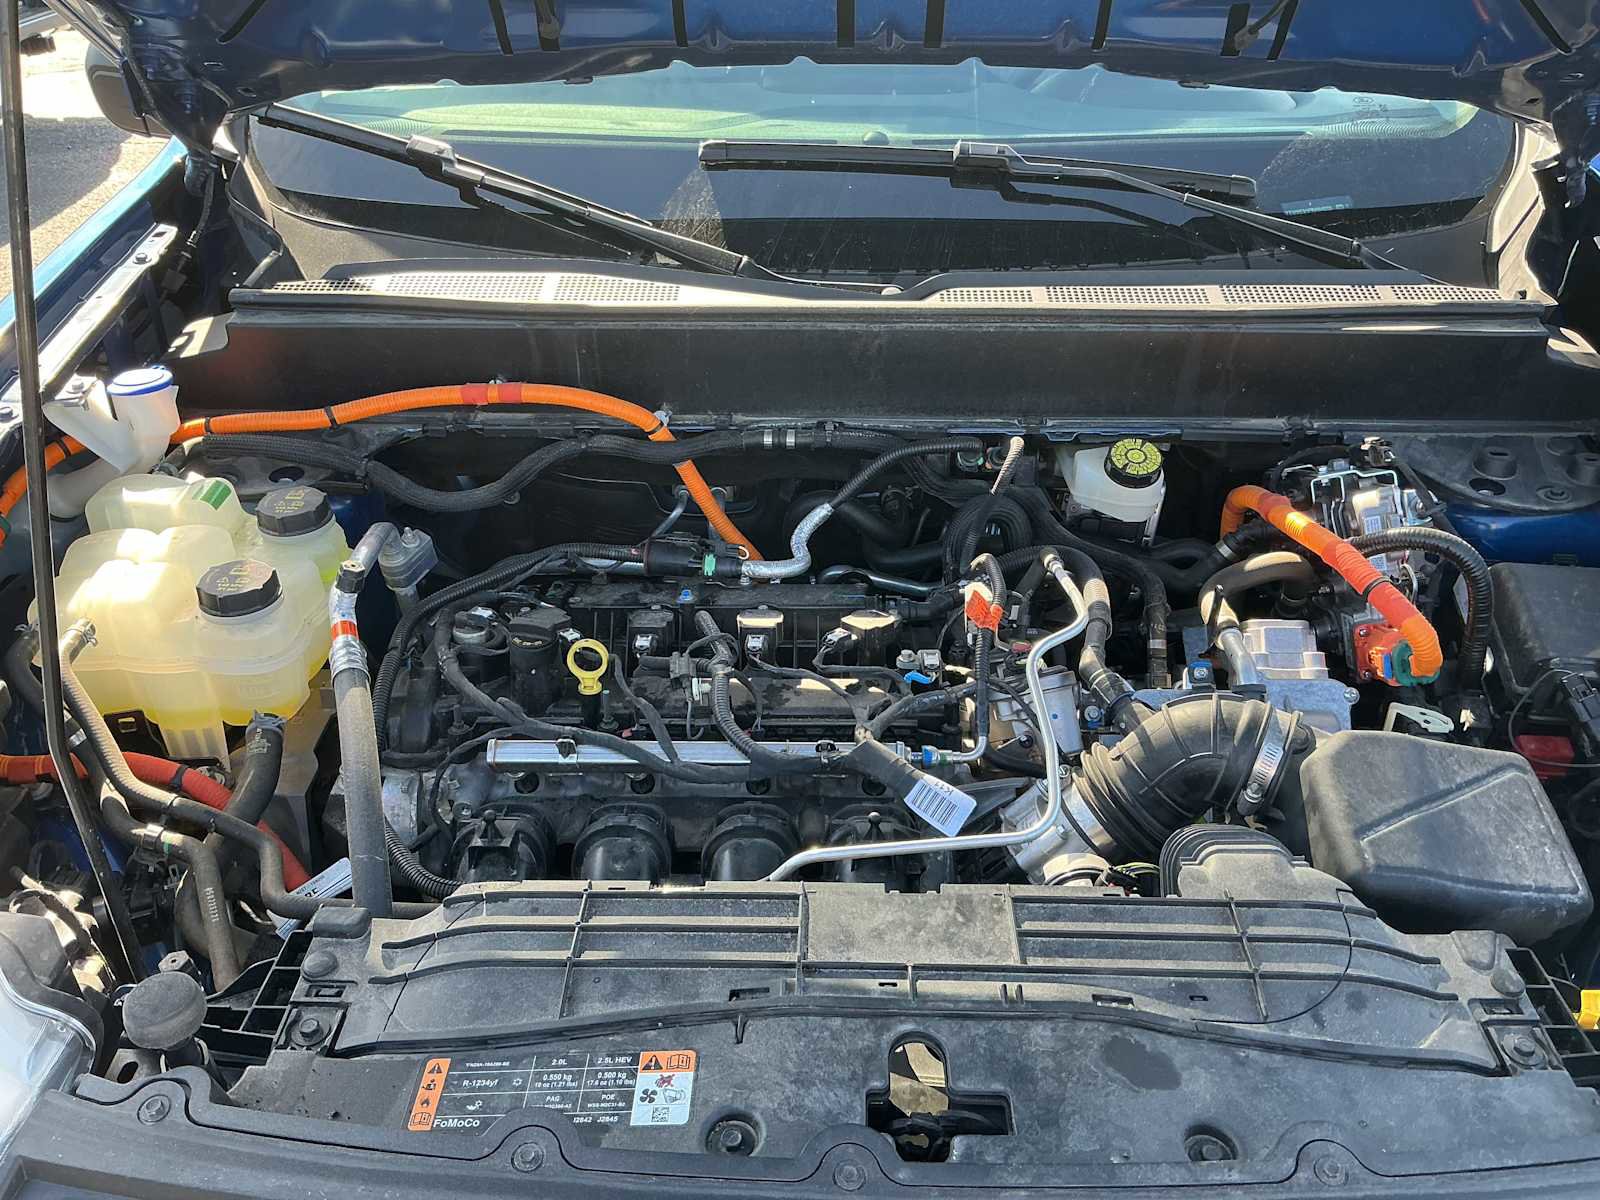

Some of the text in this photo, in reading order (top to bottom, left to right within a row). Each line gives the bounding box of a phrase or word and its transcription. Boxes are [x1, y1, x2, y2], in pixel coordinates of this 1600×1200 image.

[551, 1058, 568, 1066] 2.0L
[615, 1056, 633, 1064] HEV
[563, 1072, 573, 1082] kg
[597, 1071, 627, 1080] 0.500 kg
[462, 1079, 499, 1088] R-1234yf
[433, 1118, 480, 1128] FoMoCo
